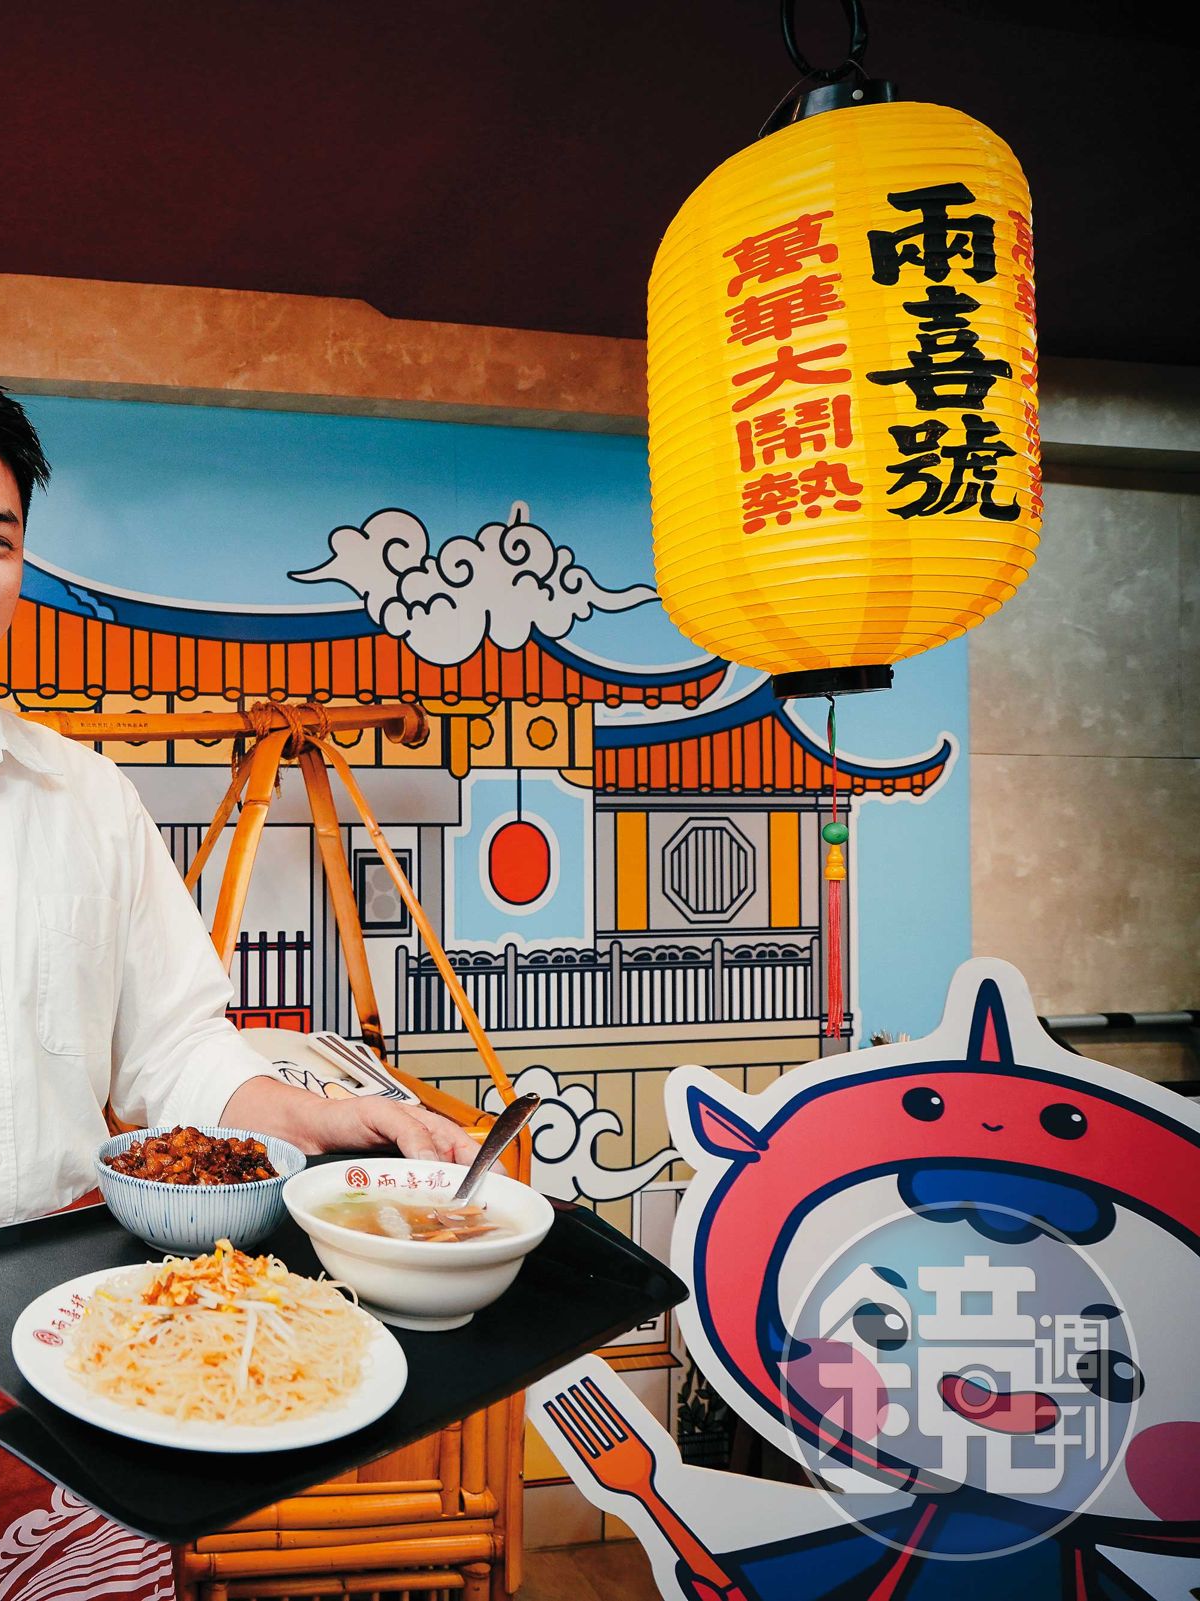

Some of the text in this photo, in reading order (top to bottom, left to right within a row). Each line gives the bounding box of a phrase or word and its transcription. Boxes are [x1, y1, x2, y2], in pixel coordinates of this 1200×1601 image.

[722, 209, 865, 535] 萬華大鬧熱
